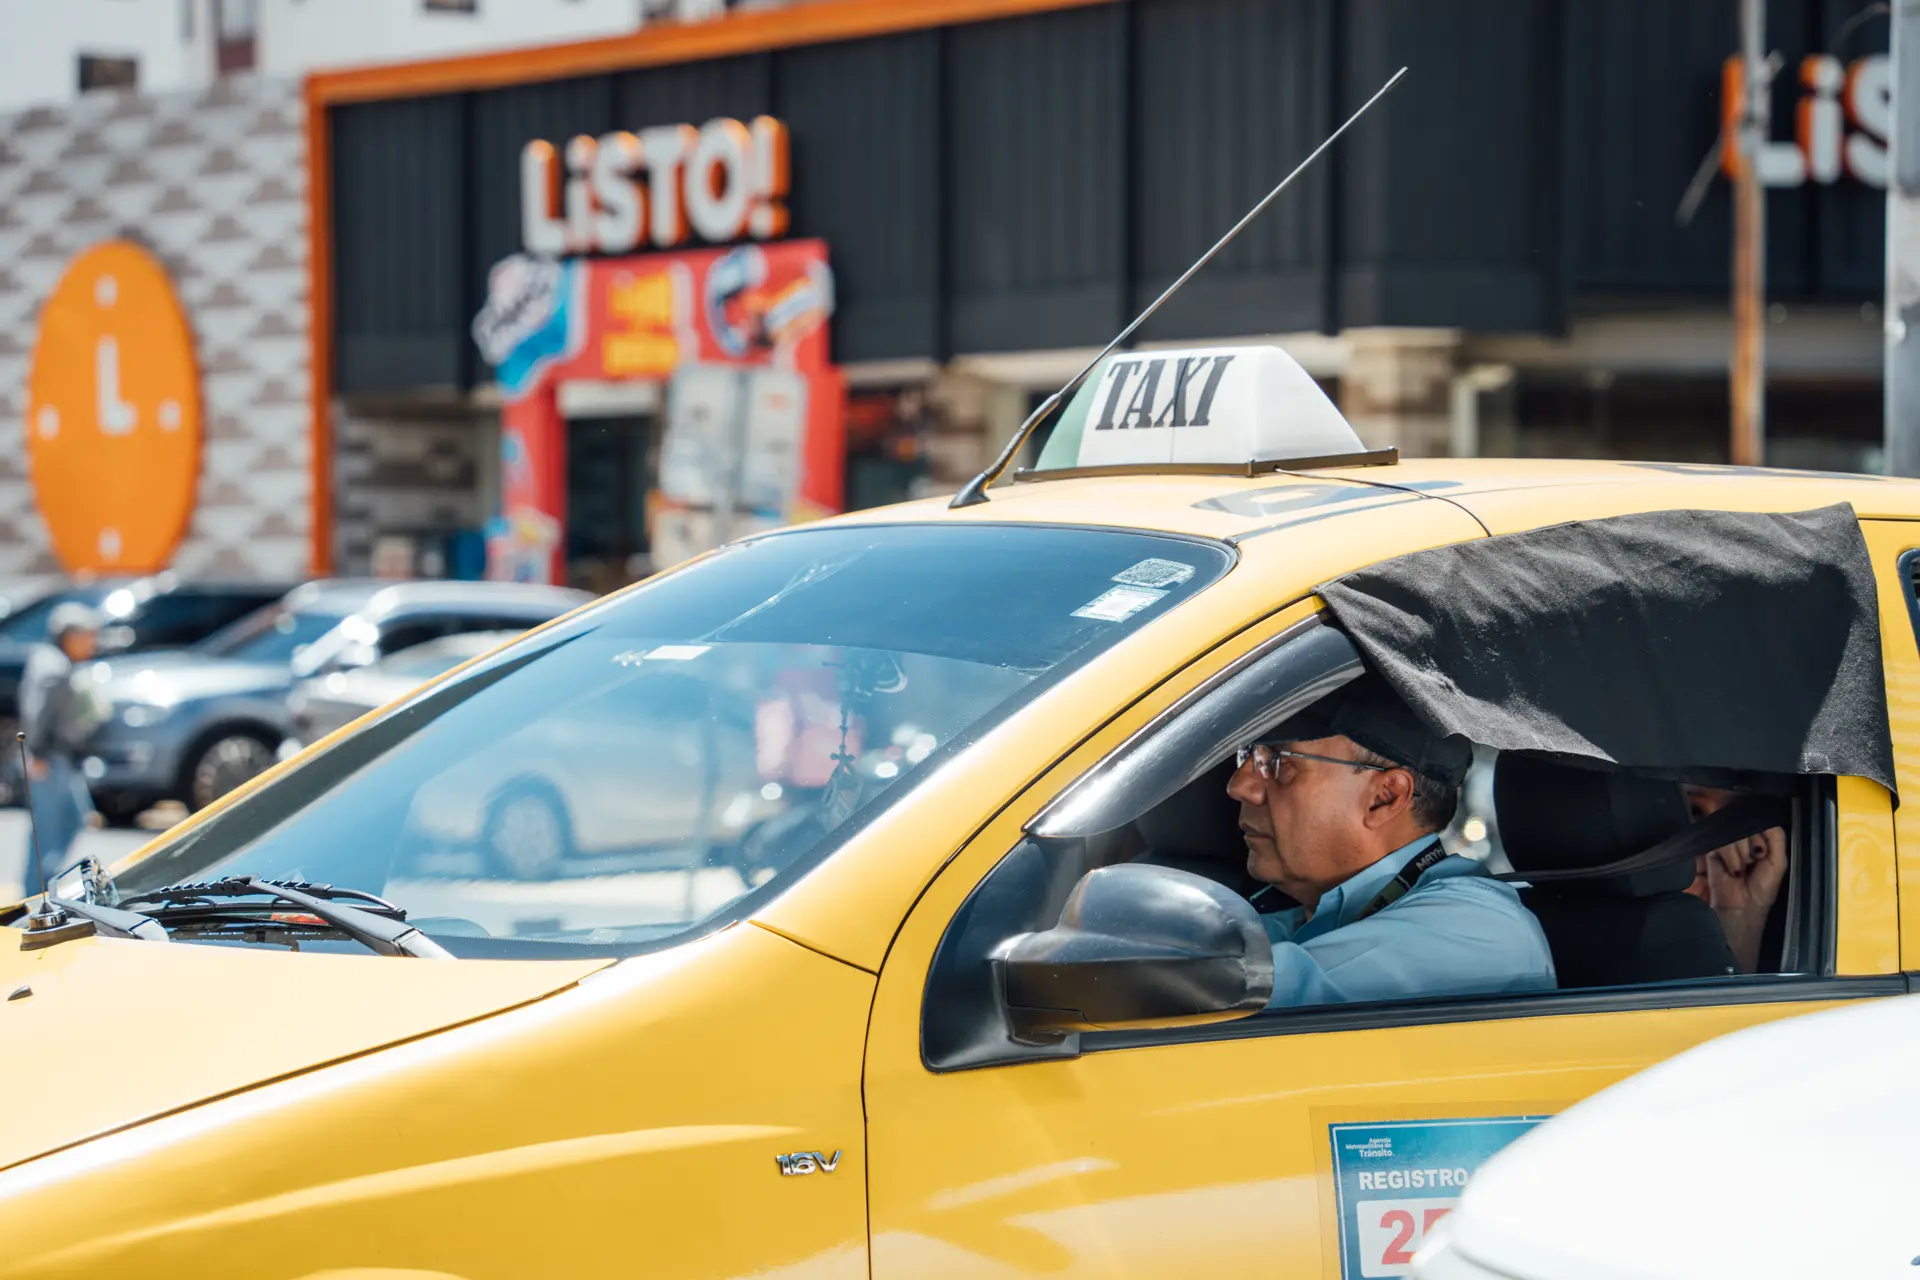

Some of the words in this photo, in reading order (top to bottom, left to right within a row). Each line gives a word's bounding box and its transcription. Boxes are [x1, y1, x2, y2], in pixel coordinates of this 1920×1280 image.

[1095, 355, 1236, 431] TAXI
[776, 1149, 843, 1176] 16V
[1360, 1149, 1393, 1158] Tránsito
[1359, 1168, 1468, 1190] REGISTRO
